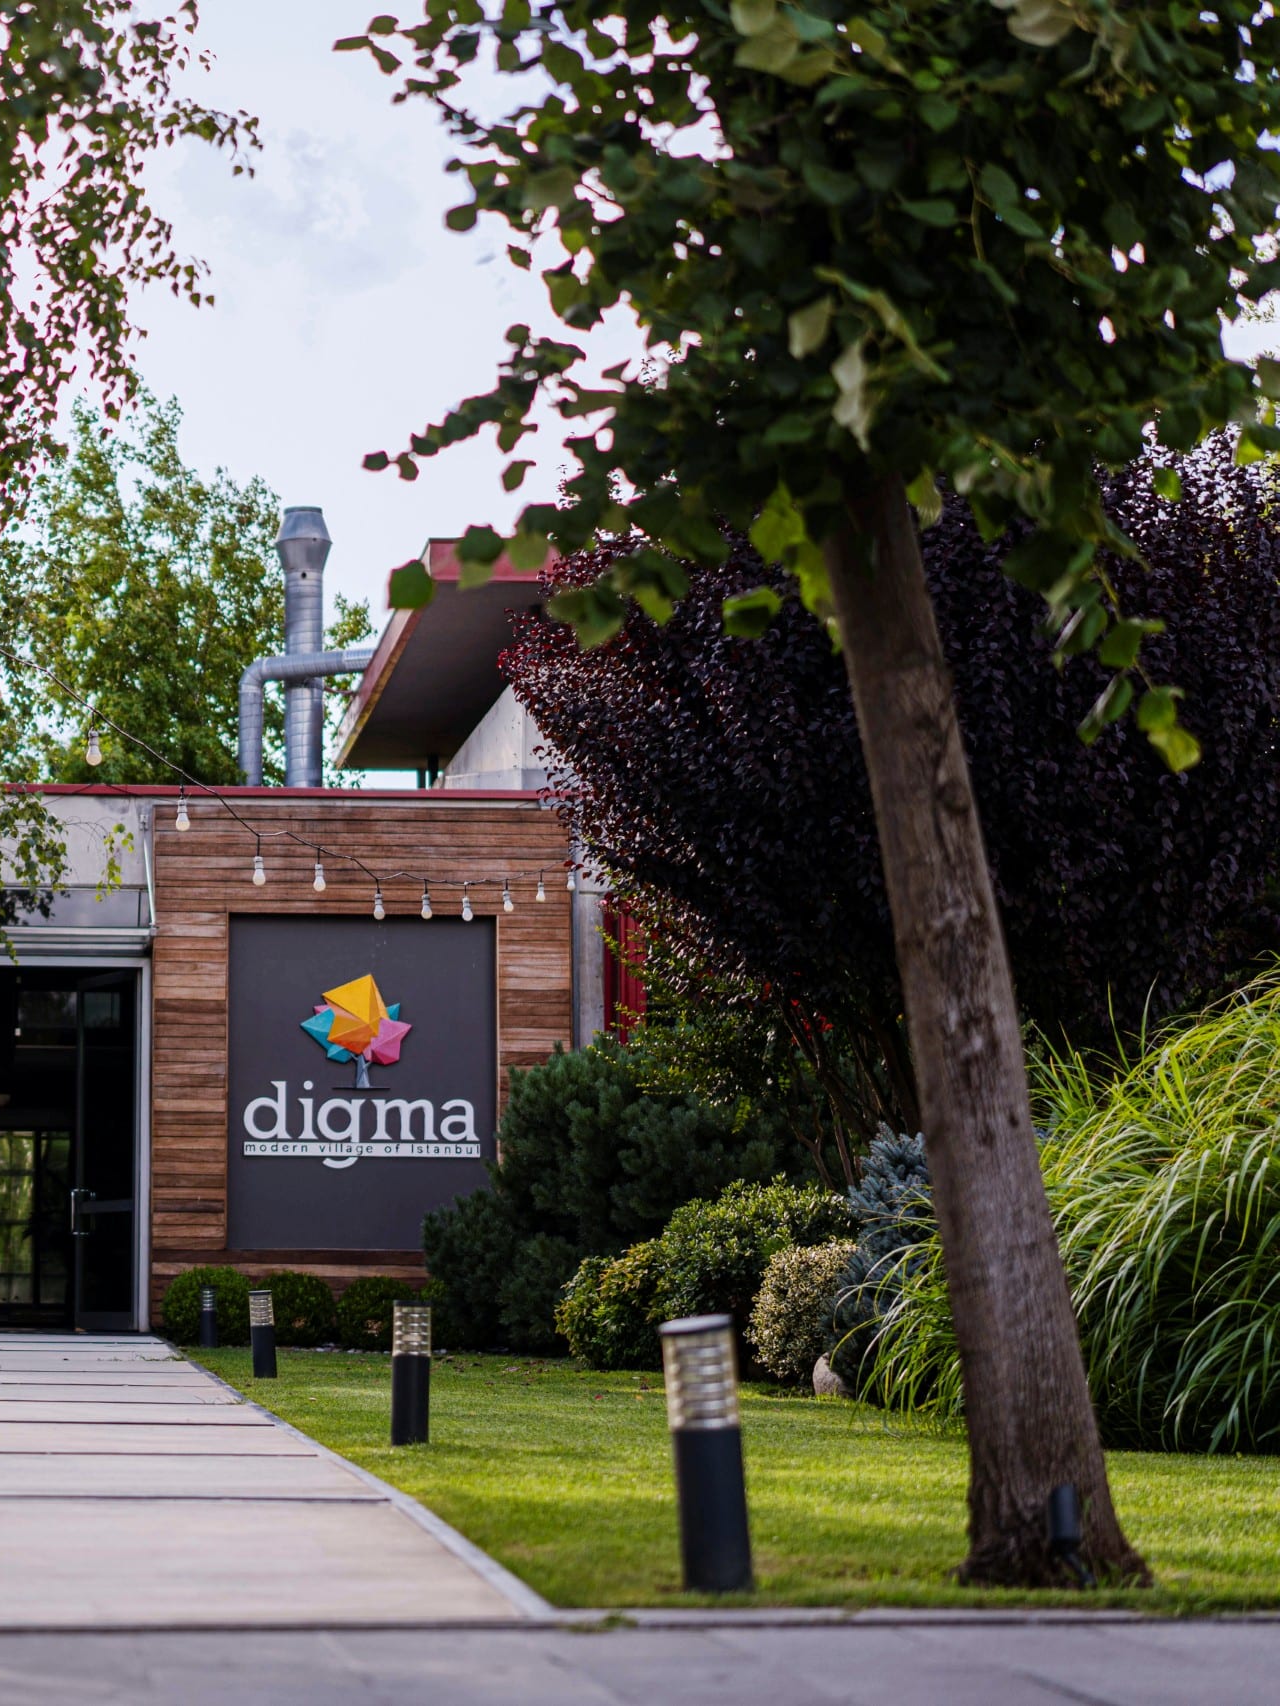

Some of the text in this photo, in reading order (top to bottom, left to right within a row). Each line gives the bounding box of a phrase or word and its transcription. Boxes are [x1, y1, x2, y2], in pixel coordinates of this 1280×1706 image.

[243, 1080, 480, 1169] digma
[245, 1142, 480, 1156] modern village of Istanbul
